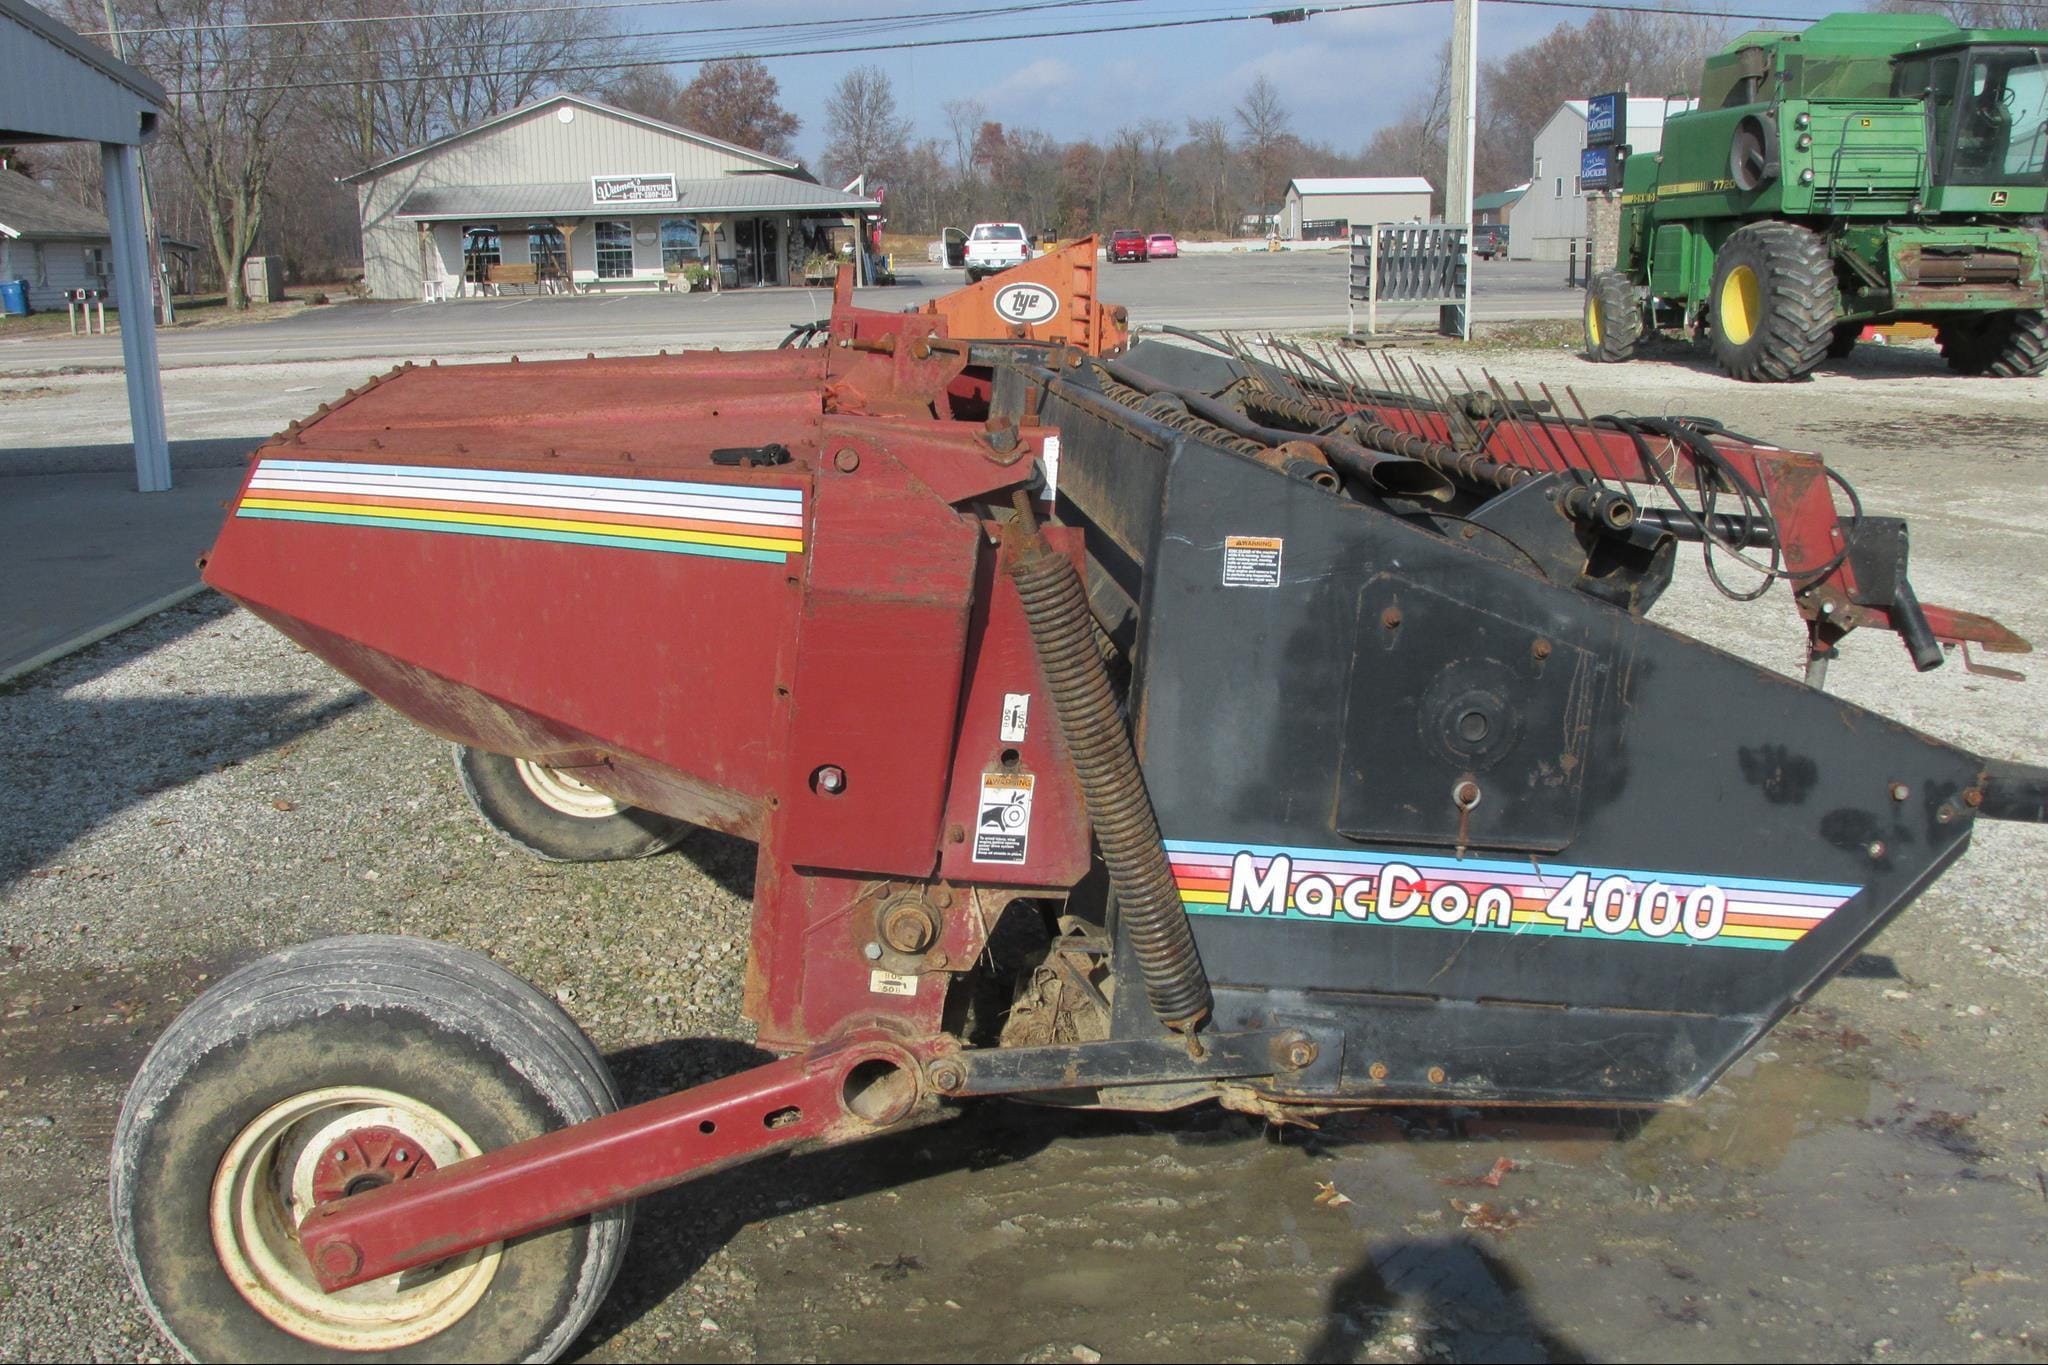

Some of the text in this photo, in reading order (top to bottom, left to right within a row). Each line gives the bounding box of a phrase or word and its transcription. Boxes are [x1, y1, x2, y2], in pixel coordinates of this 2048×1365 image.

[1588, 119, 1612, 131] LOCKER
[1582, 168, 1607, 178] LOCKER
[633, 184, 671, 193] FURNITURE
[1713, 179, 1737, 192] 7720
[1012, 290, 1040, 316] tye
[1241, 540, 1273, 548] WARNING
[1226, 850, 1728, 941] MacDon 4000
